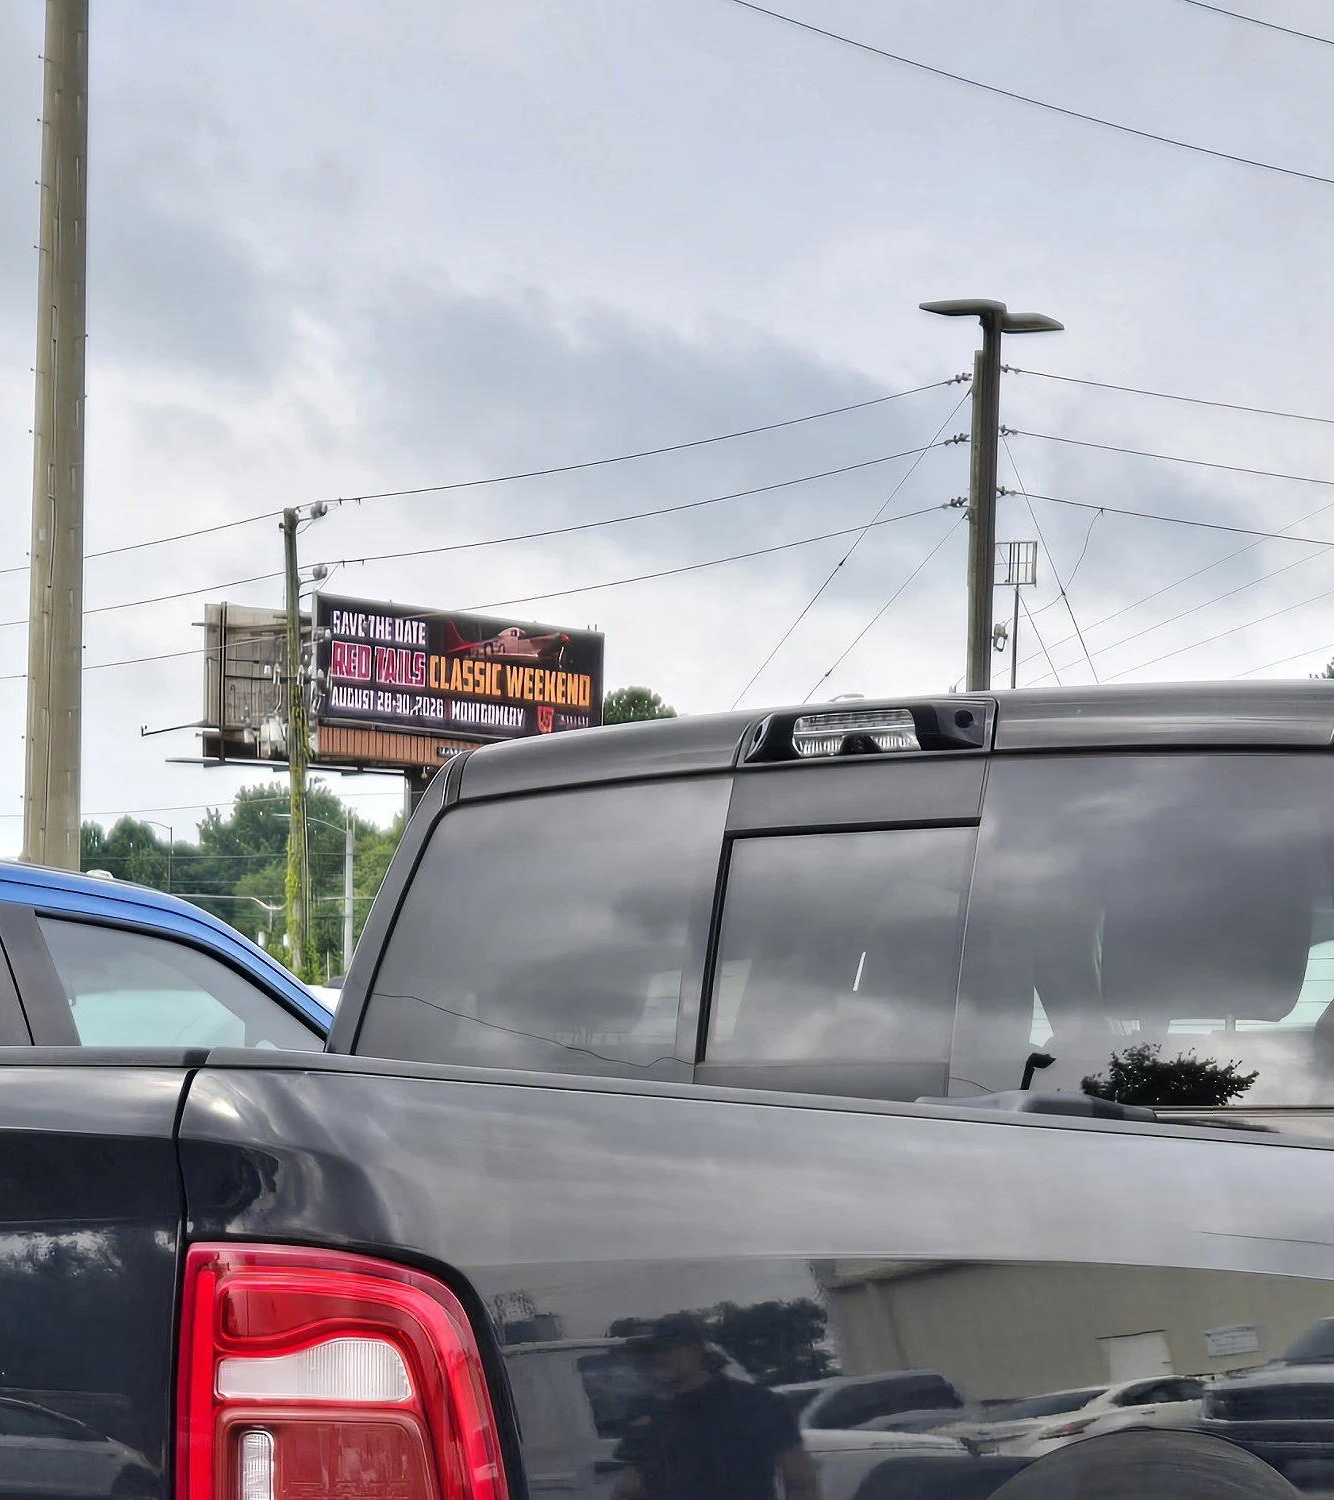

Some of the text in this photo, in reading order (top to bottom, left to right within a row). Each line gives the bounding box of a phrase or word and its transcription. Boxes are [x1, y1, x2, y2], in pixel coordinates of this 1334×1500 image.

[333, 610, 426, 645] SAVE THE DATE
[331, 640, 426, 687] RED TAILS
[429, 655, 591, 707] CLASSIC WEEKEND
[331, 686, 374, 710] AUGUST
[451, 700, 524, 727] MONTGOMERY
